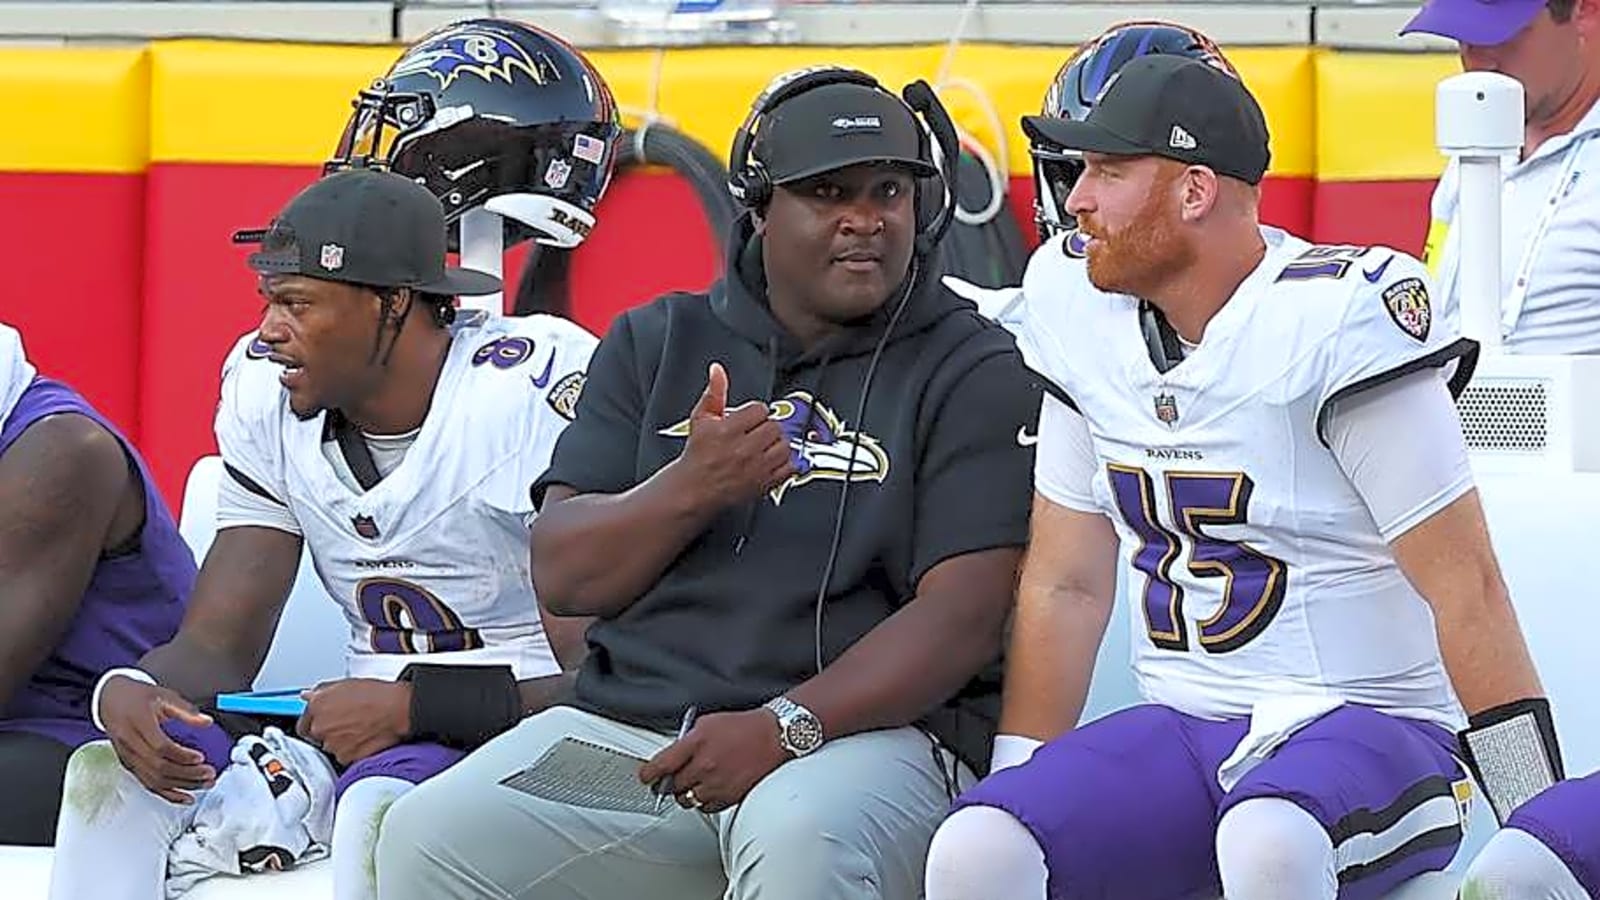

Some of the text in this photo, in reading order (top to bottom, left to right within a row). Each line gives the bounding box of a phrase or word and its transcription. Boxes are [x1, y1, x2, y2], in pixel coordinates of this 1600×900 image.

[471, 336, 536, 369] 8
[1145, 448, 1204, 461] RAVENS
[1106, 462, 1288, 654] 15
